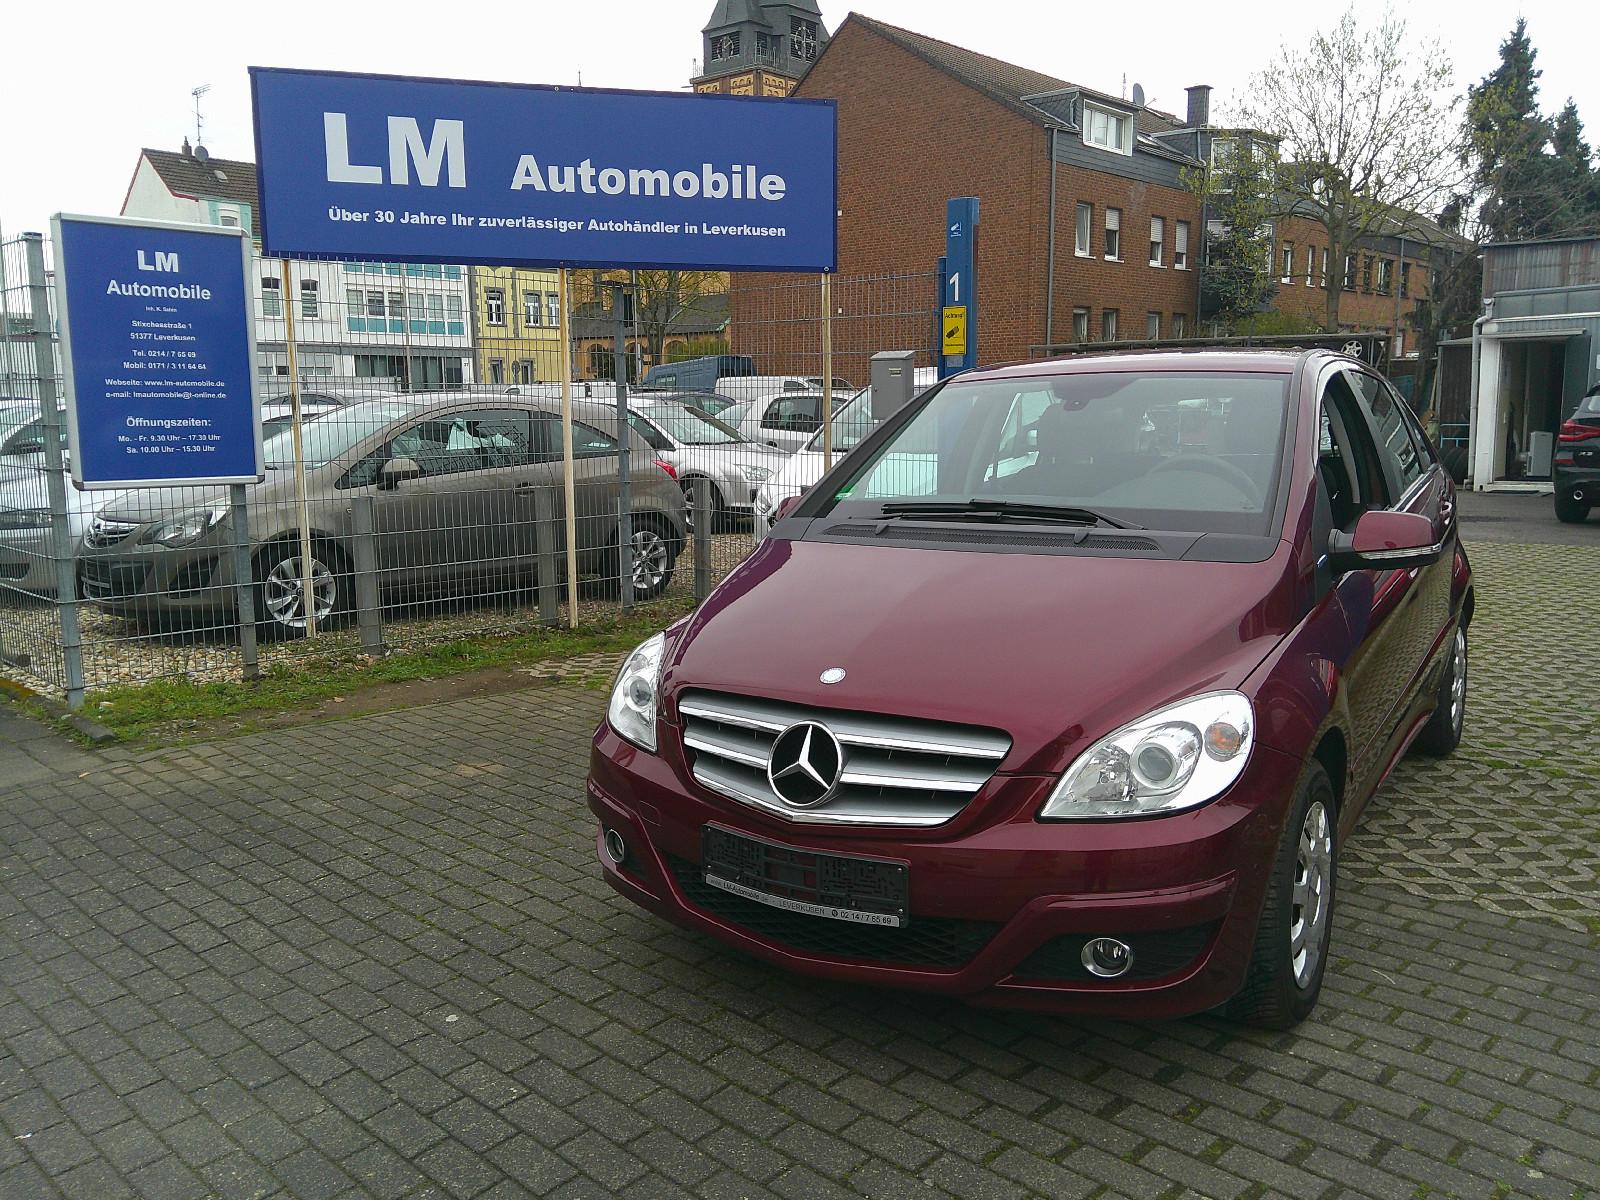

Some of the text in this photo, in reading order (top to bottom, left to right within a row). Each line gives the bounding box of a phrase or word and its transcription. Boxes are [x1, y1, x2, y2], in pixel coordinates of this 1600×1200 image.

[323, 111, 786, 201] LM Automobile
[328, 205, 786, 236] Über 30 Jahre Ihr zuverlässiger Autohändler in Leverkusen
[137, 249, 179, 273] LM
[106, 279, 212, 300] Automobile
[950, 272, 959, 302] 1
[126, 416, 212, 428] Öffnungszeiten:
[780, 900, 825, 915] LEVERKUSEN
